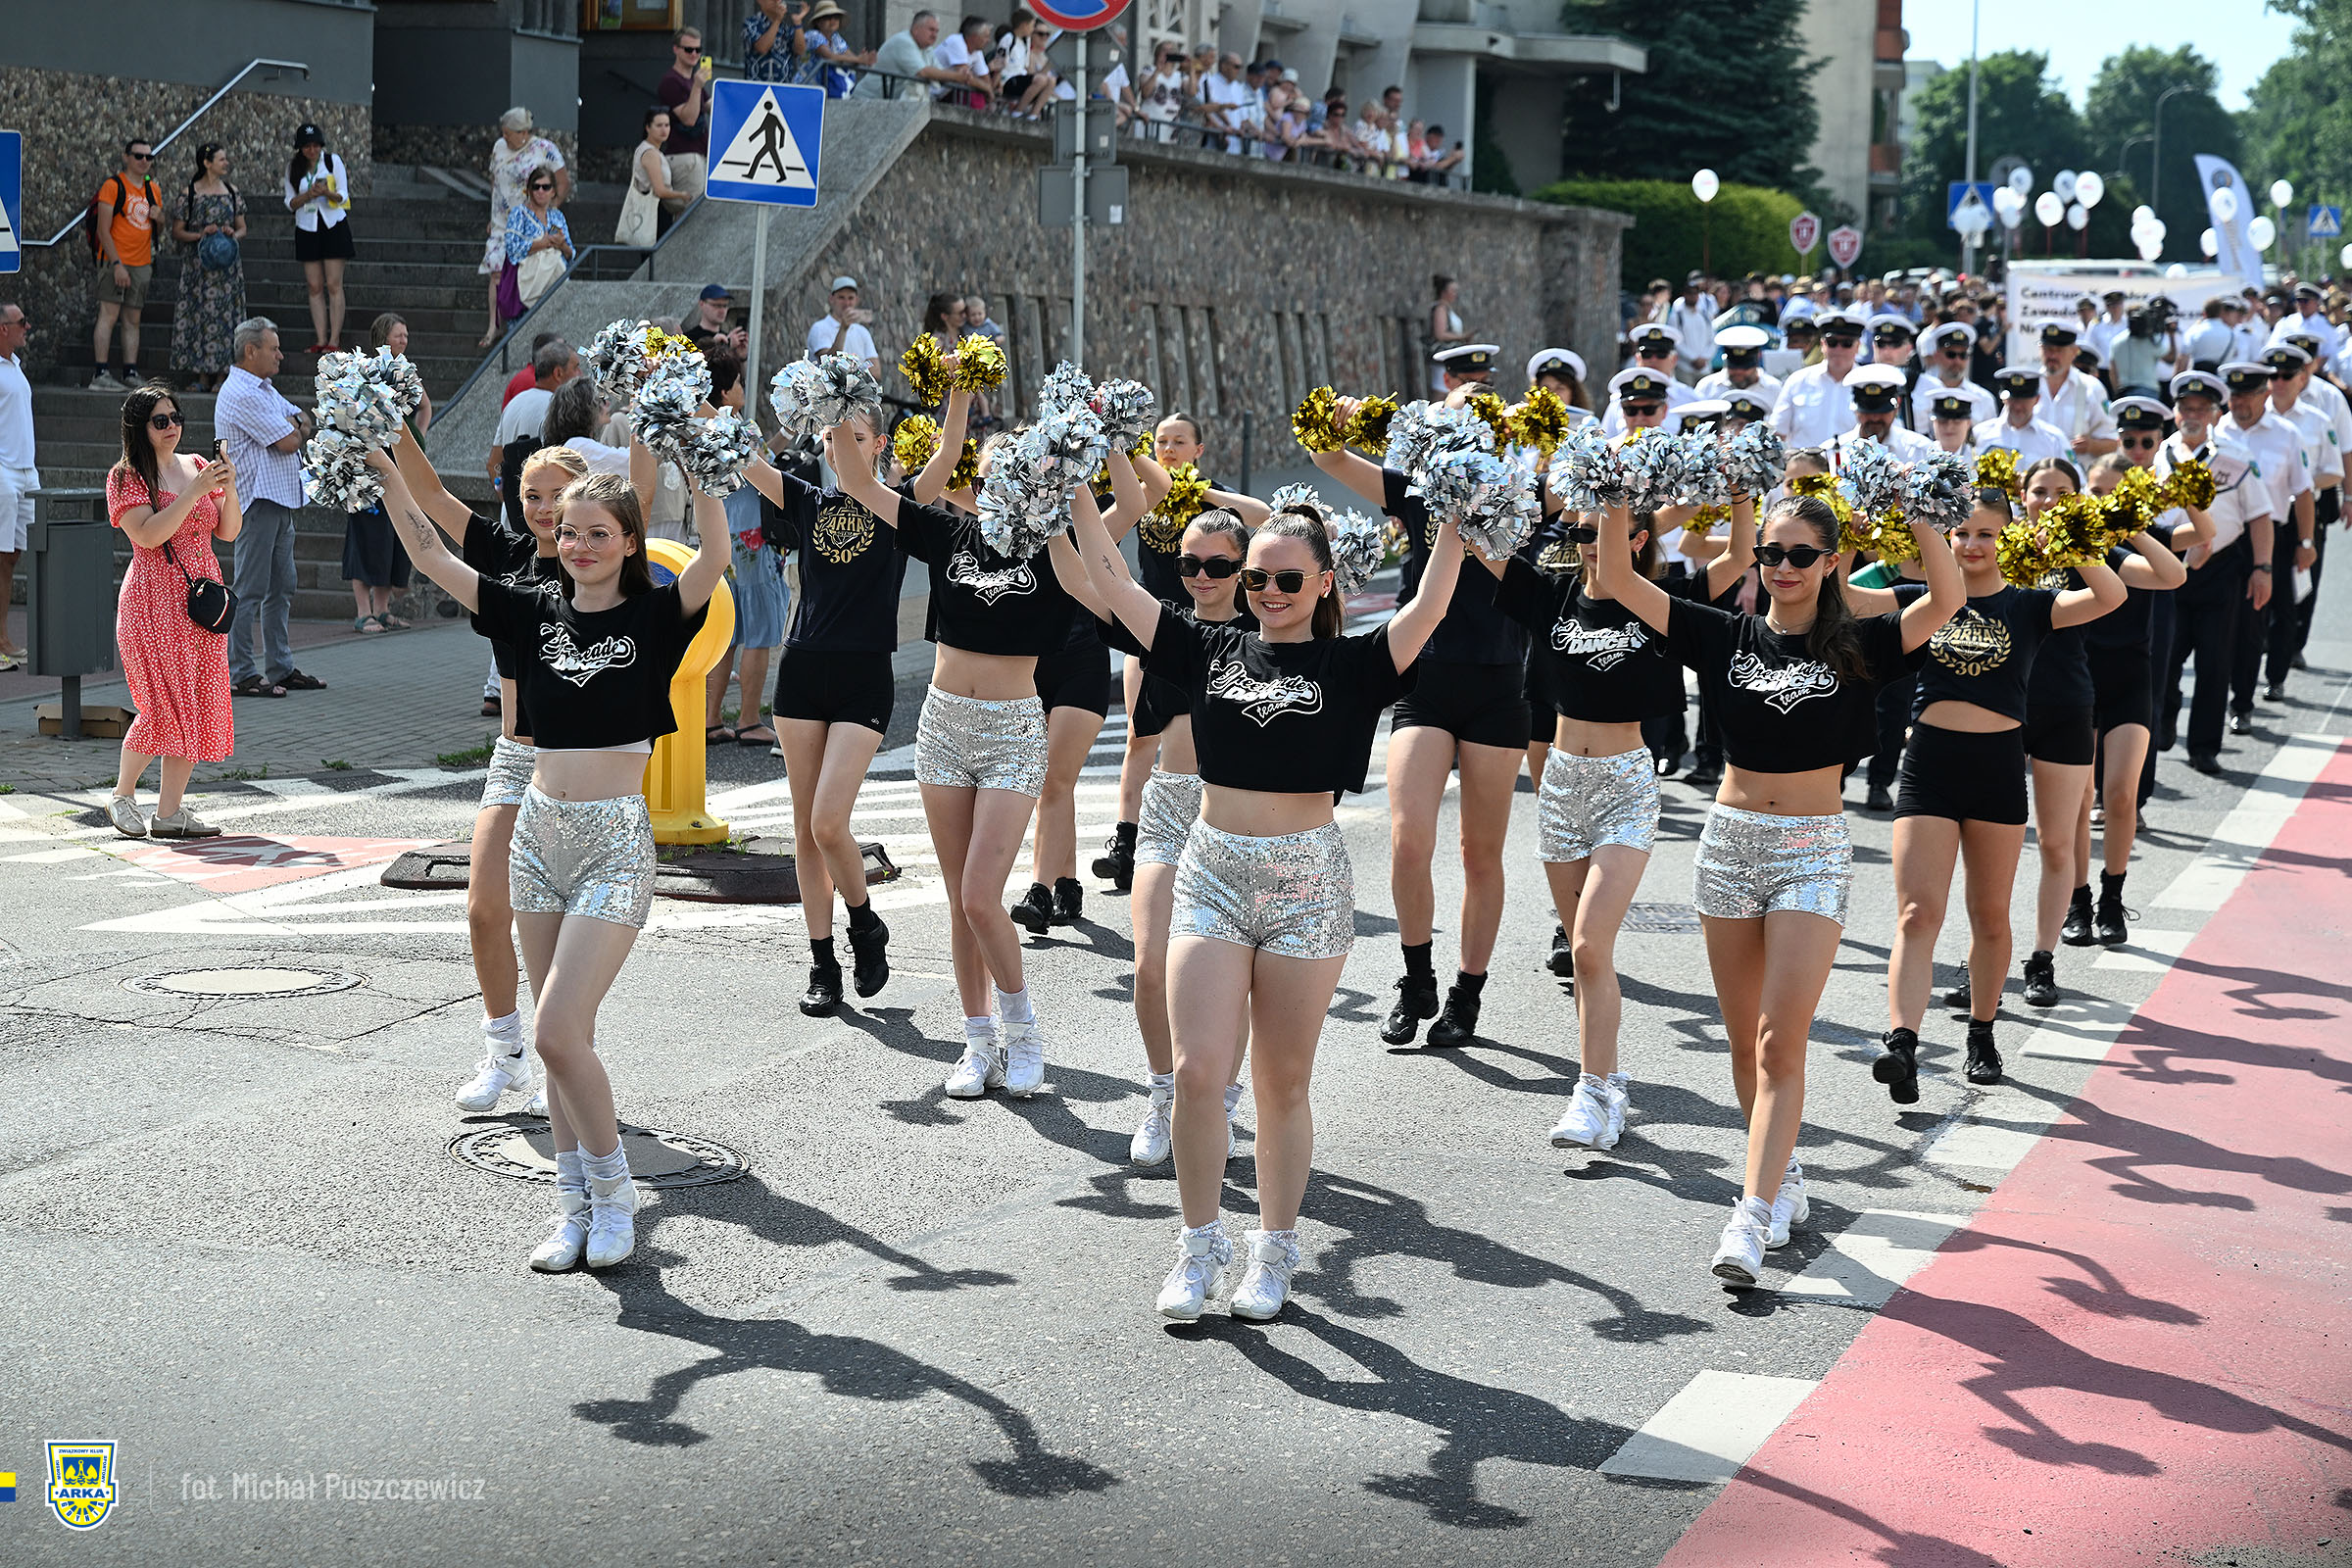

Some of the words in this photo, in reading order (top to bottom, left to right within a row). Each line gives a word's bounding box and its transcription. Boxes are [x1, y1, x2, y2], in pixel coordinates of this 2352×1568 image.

[1157, 542, 1177, 554] 30
[830, 549, 853, 564] 30
[1549, 550, 1580, 564] ARK
[1567, 637, 1630, 655] DANCE
[1955, 662, 1982, 676] 30
[1780, 688, 1811, 706] team
[1256, 700, 1293, 719] team
